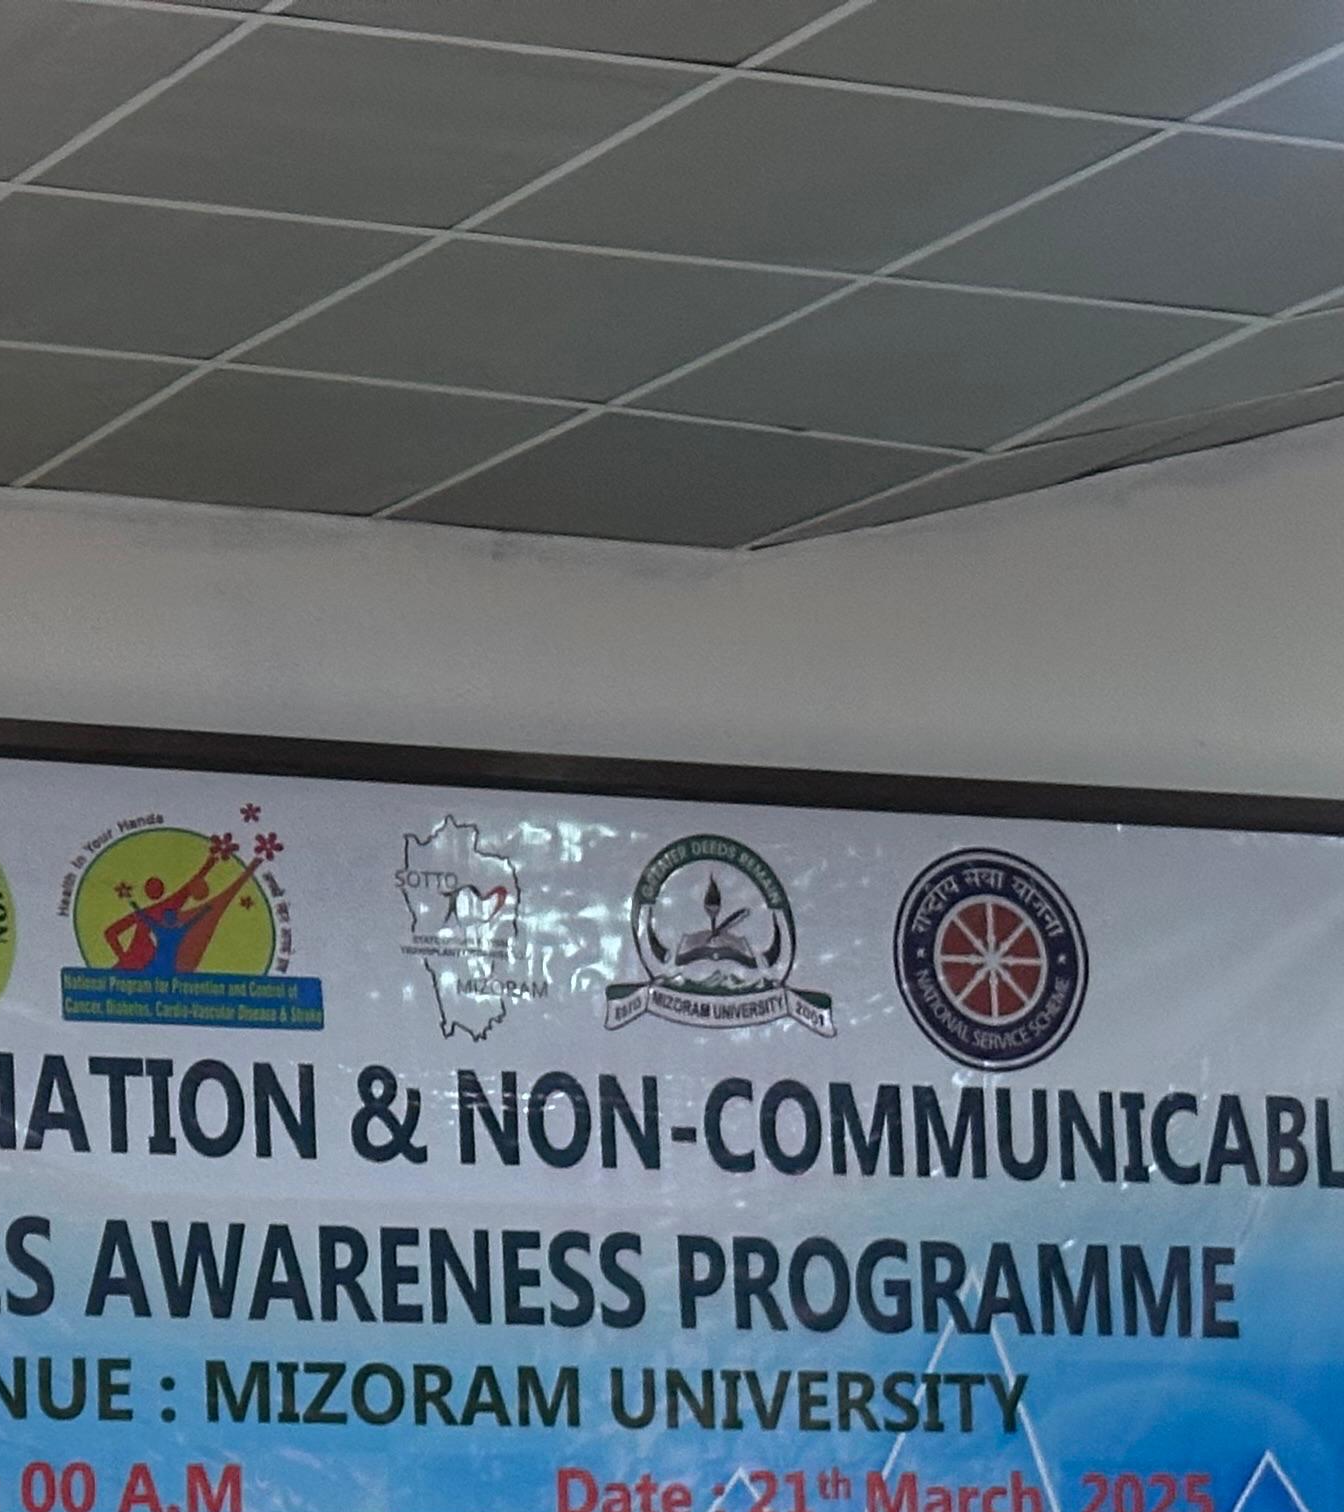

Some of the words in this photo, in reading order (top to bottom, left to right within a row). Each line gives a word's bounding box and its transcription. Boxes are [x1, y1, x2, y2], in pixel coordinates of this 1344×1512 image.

[56, 872, 77, 917] Health
[83, 829, 112, 853] Your
[116, 813, 164, 832] Hands
[691, 840, 736, 858] DEEDS
[394, 870, 459, 889] SOTTO
[456, 979, 549, 999] MIZORAM
[652, 991, 710, 1018] MIZORAM
[713, 996, 785, 1020] UNIVERSITY
[795, 1001, 825, 1027] 2001
[916, 968, 970, 1042] NATIONAL
[972, 1027, 1032, 1049] SERVICE
[1029, 976, 1070, 1036] SCHEME
[350, 1064, 428, 1164] &
[458, 1069, 1344, 1190] NON-COMMUNICABL
[84, 1218, 645, 1328] AWARENESS
[677, 1233, 1241, 1339] PROGRAMME
[160, 1375, 176, 1423] :
[206, 1360, 582, 1429] MIZORAM
[609, 1366, 1030, 1434] UNIVERSITY
